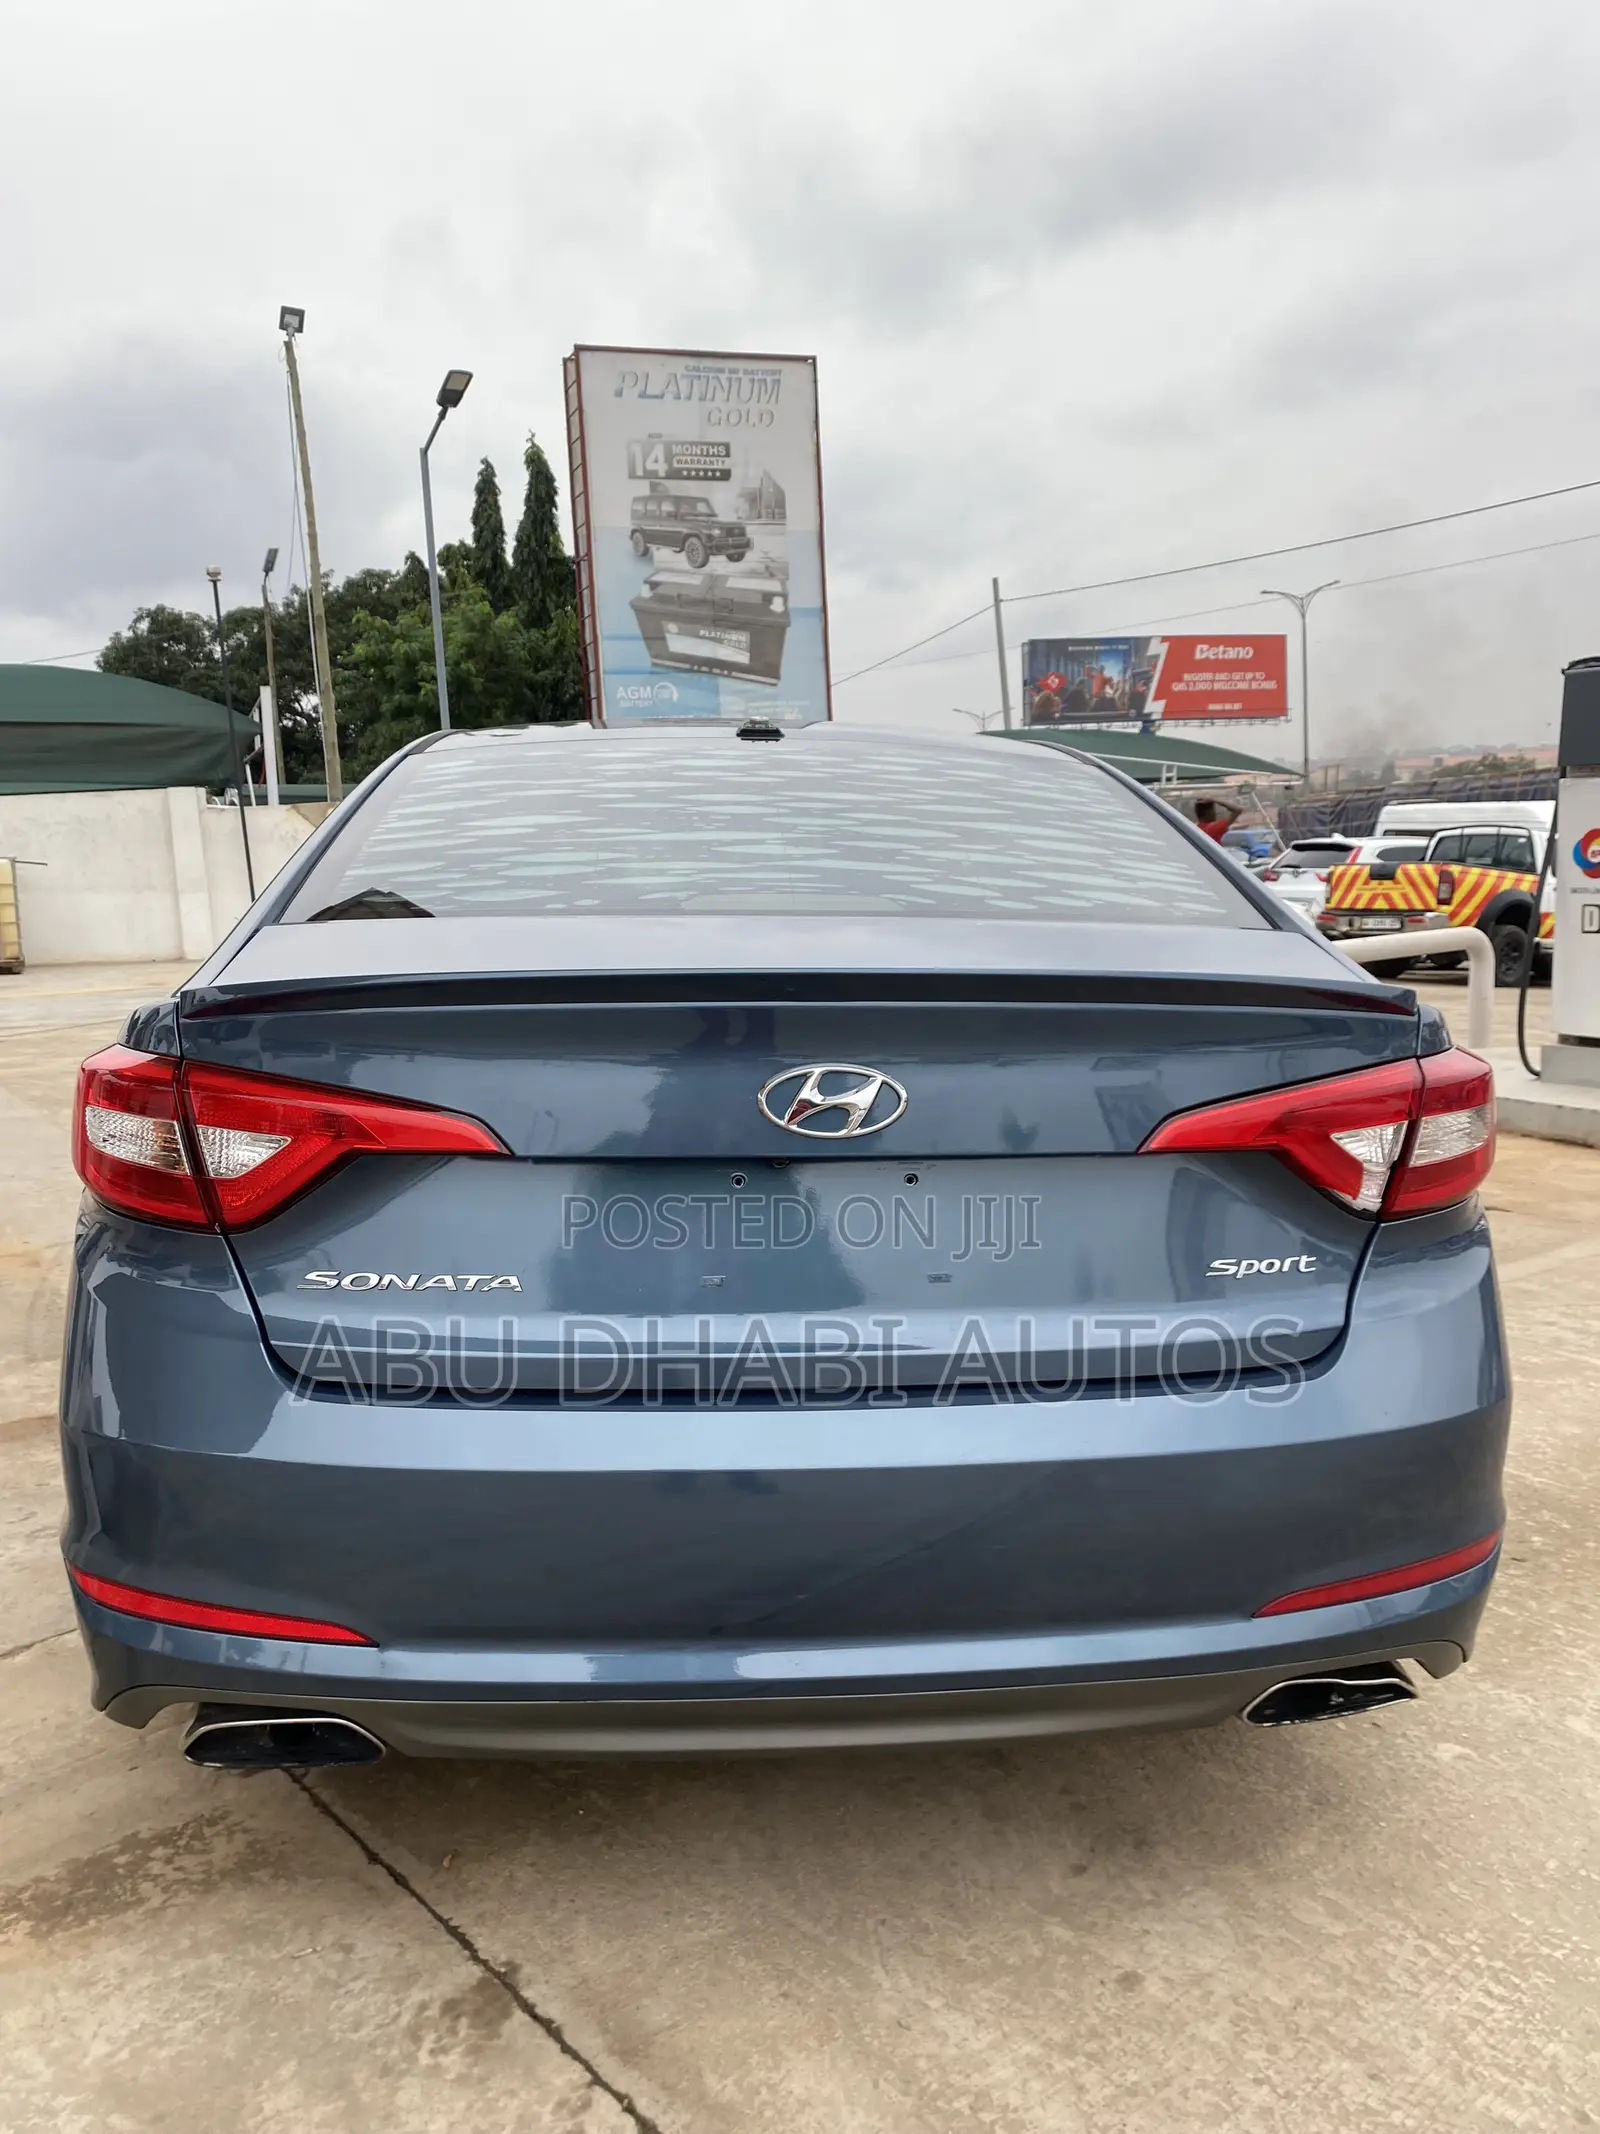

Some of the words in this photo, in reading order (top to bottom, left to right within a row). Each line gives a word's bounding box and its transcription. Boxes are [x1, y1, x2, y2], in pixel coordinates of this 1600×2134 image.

[613, 370, 782, 405] PLATINUM
[707, 406, 775, 428] GOLD
[629, 442, 669, 477] 14
[672, 444, 727, 456] MONTHS
[675, 457, 726, 467] WARRANTY
[699, 629, 747, 641] PLATINUM
[1194, 643, 1255, 660] Betano
[616, 685, 652, 699] AGM
[1205, 1254, 1317, 1279] Sport
[297, 1270, 523, 1292] SONATA
